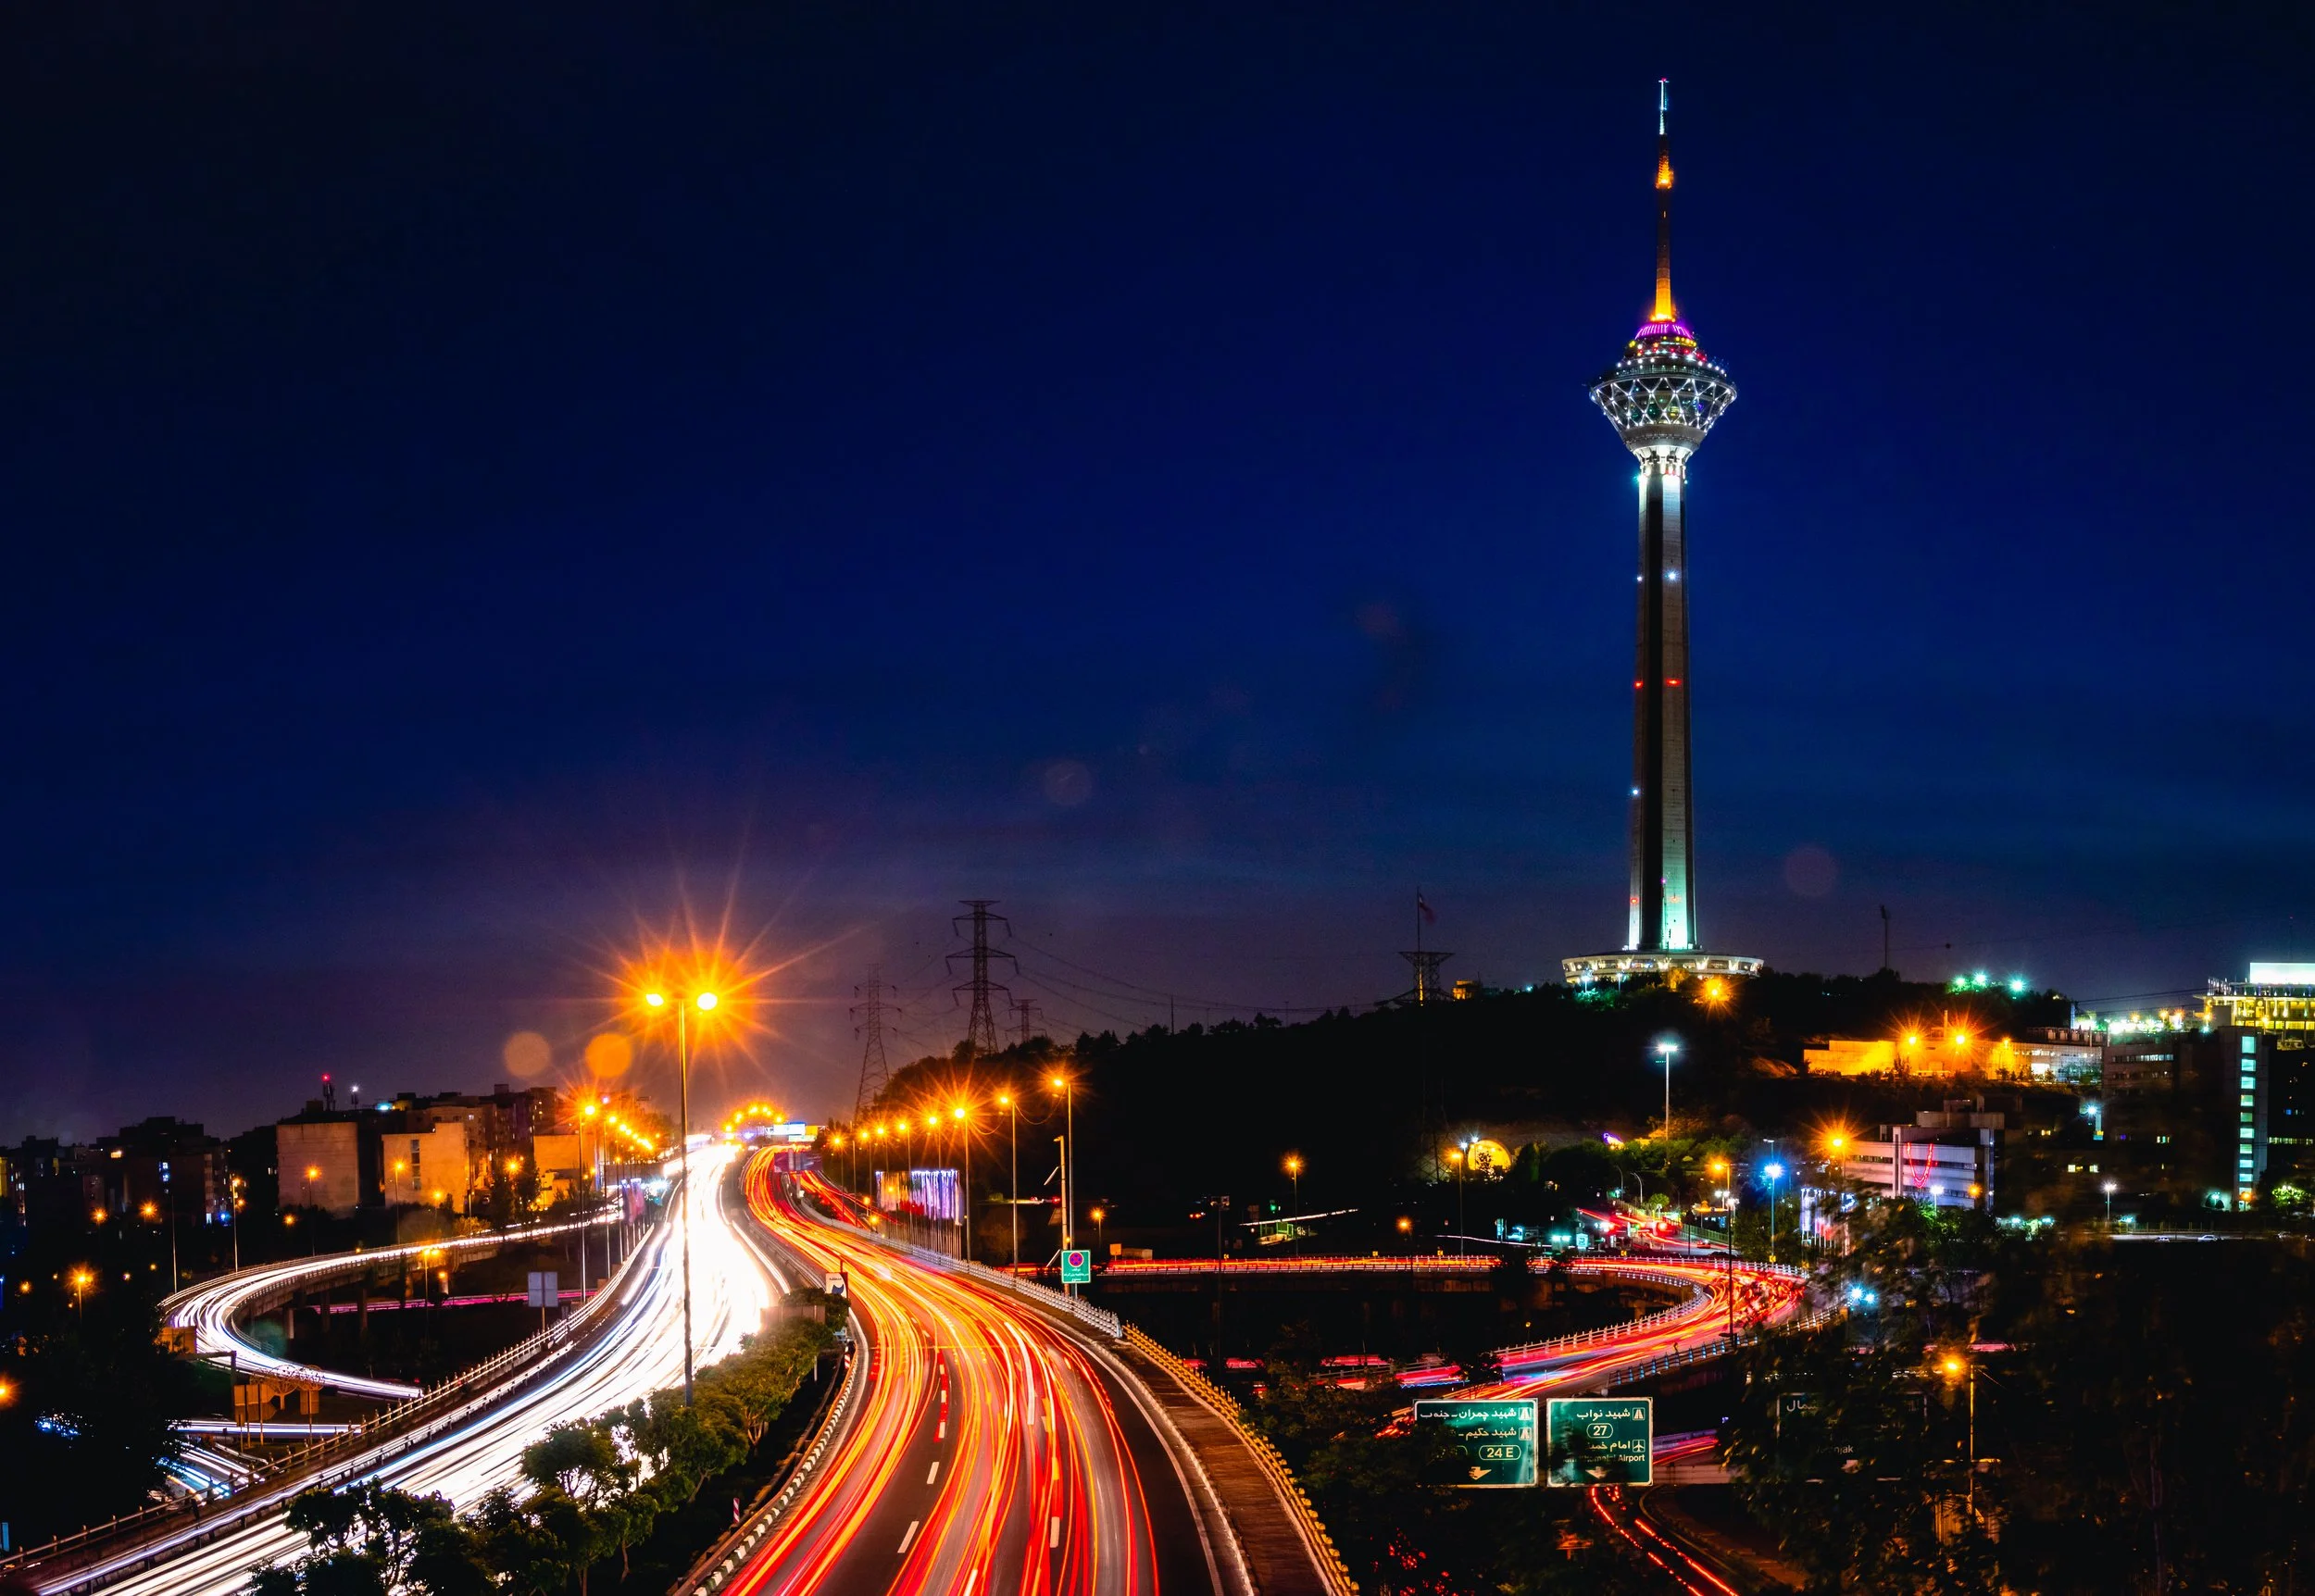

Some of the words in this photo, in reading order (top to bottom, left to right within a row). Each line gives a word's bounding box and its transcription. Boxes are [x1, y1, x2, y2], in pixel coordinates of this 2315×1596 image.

[1458, 1407, 1490, 1422] چمران
[1491, 1407, 1517, 1419] شهید
[1576, 1408, 1603, 1422] نواب
[1605, 1407, 1631, 1420] شهید
[1465, 1428, 1490, 1441] حکیم
[1491, 1427, 1517, 1438] شهید
[1593, 1425, 1608, 1436] 27
[1585, 1440, 1608, 1451] خمین
[1609, 1440, 1631, 1453] امام
[1486, 1447, 1503, 1459] 24
[1506, 1447, 1514, 1459] E
[1618, 1453, 1646, 1464] Airport
